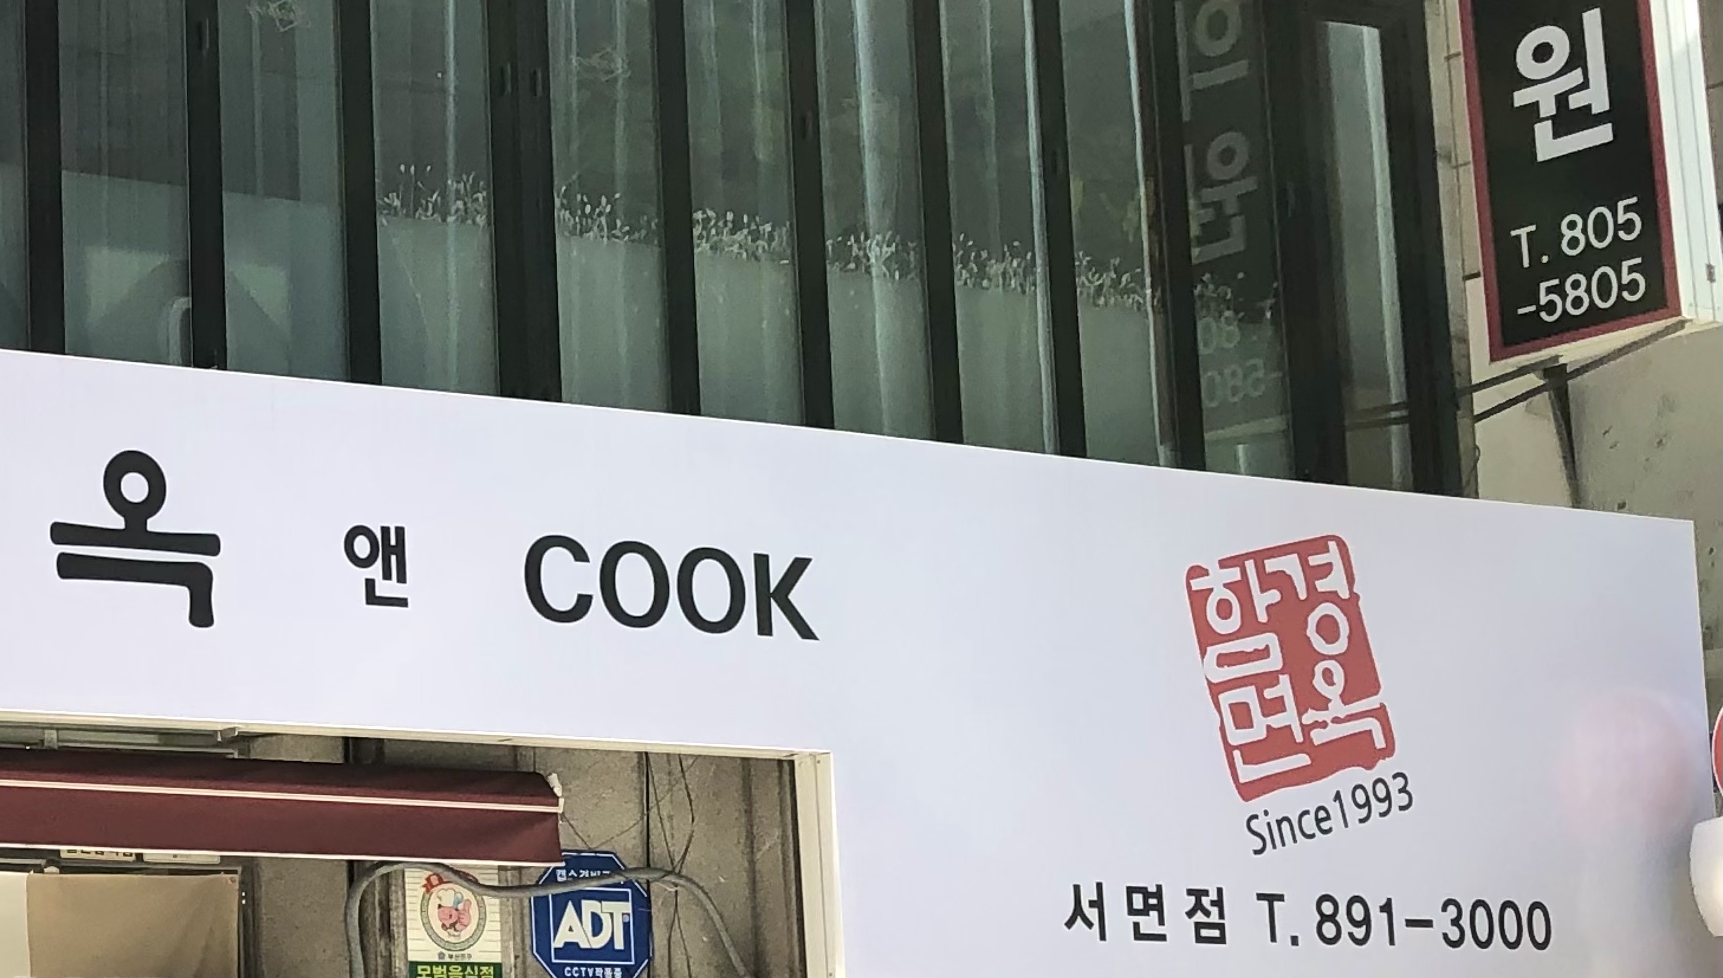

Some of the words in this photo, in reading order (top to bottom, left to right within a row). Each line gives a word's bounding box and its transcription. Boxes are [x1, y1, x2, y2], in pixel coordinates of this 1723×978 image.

[1513, 8, 1613, 162] 원
[1516, 258, 1646, 322] -5805
[343, 525, 409, 607] 앤
[524, 534, 819, 640] COOK
[553, 899, 631, 950] ADT
[1065, 881, 1228, 946] 서면점
